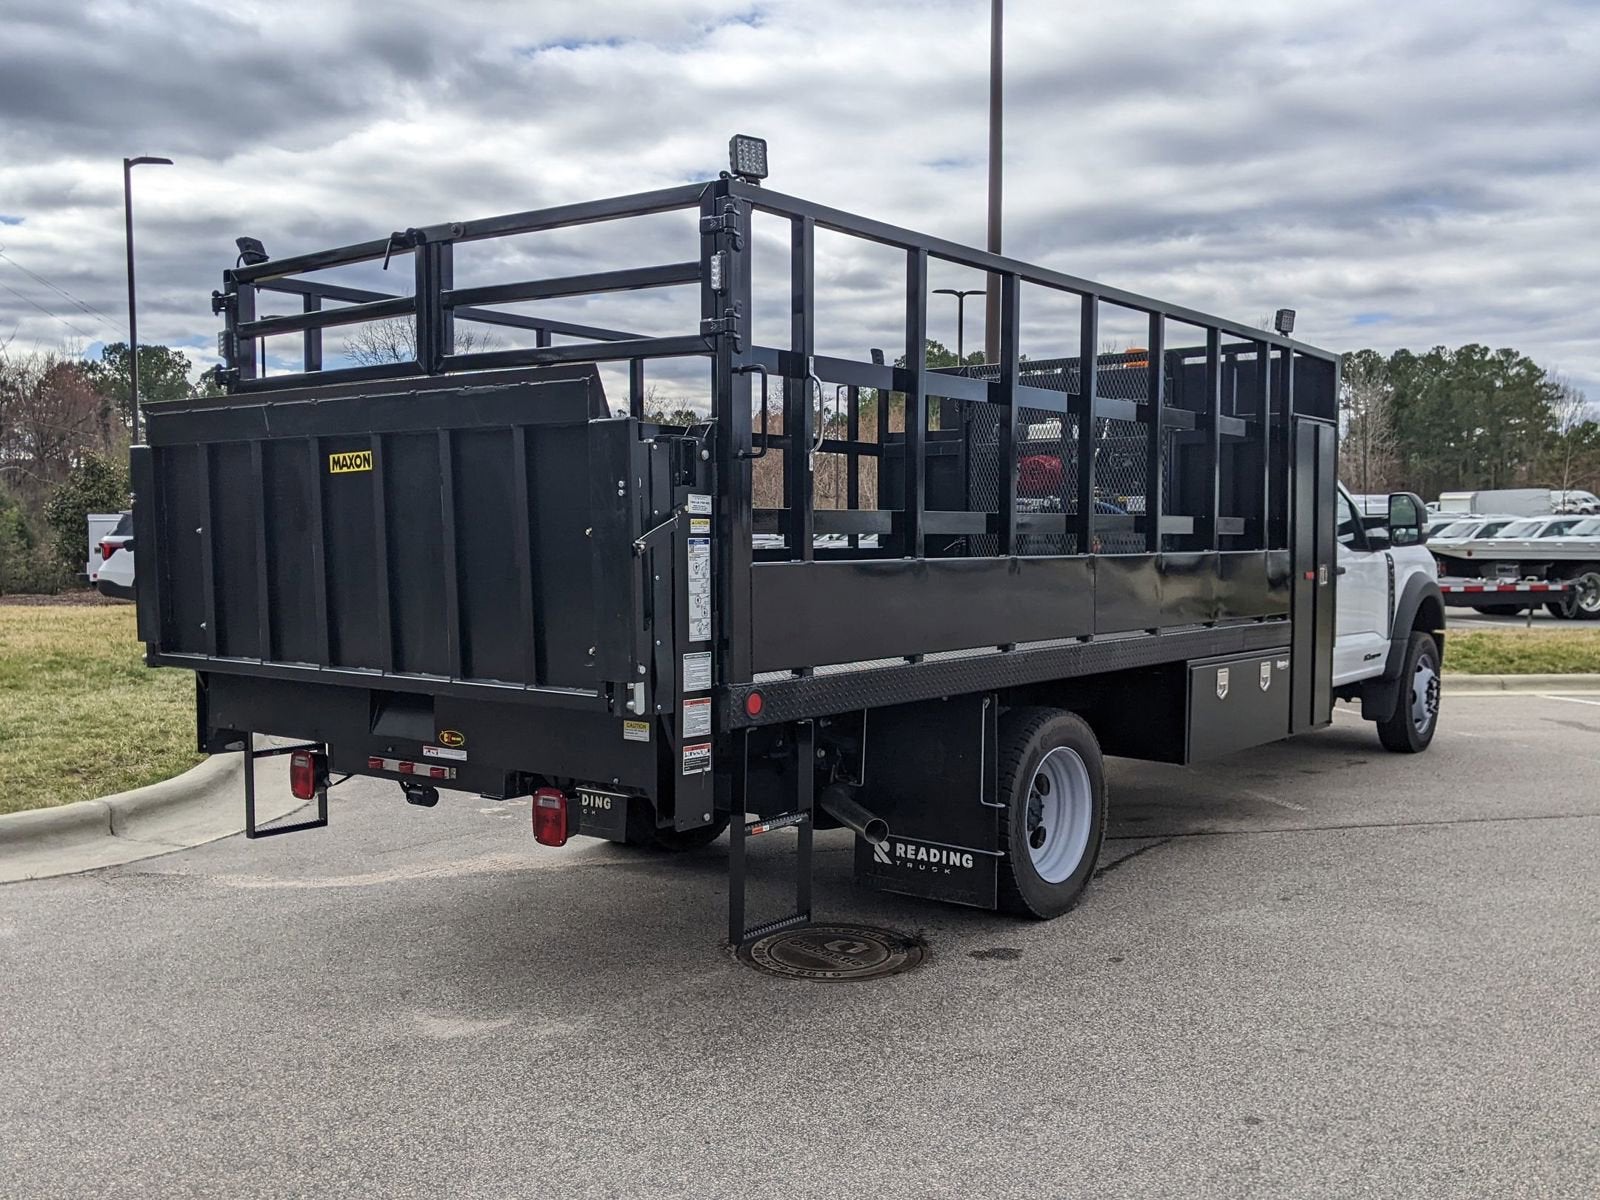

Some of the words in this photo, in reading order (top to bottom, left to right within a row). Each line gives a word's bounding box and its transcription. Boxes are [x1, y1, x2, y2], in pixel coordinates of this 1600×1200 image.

[332, 453, 371, 471] MAXON
[581, 793, 612, 810] DING
[895, 842, 974, 869] READING
[896, 860, 951, 875] TRUCK
